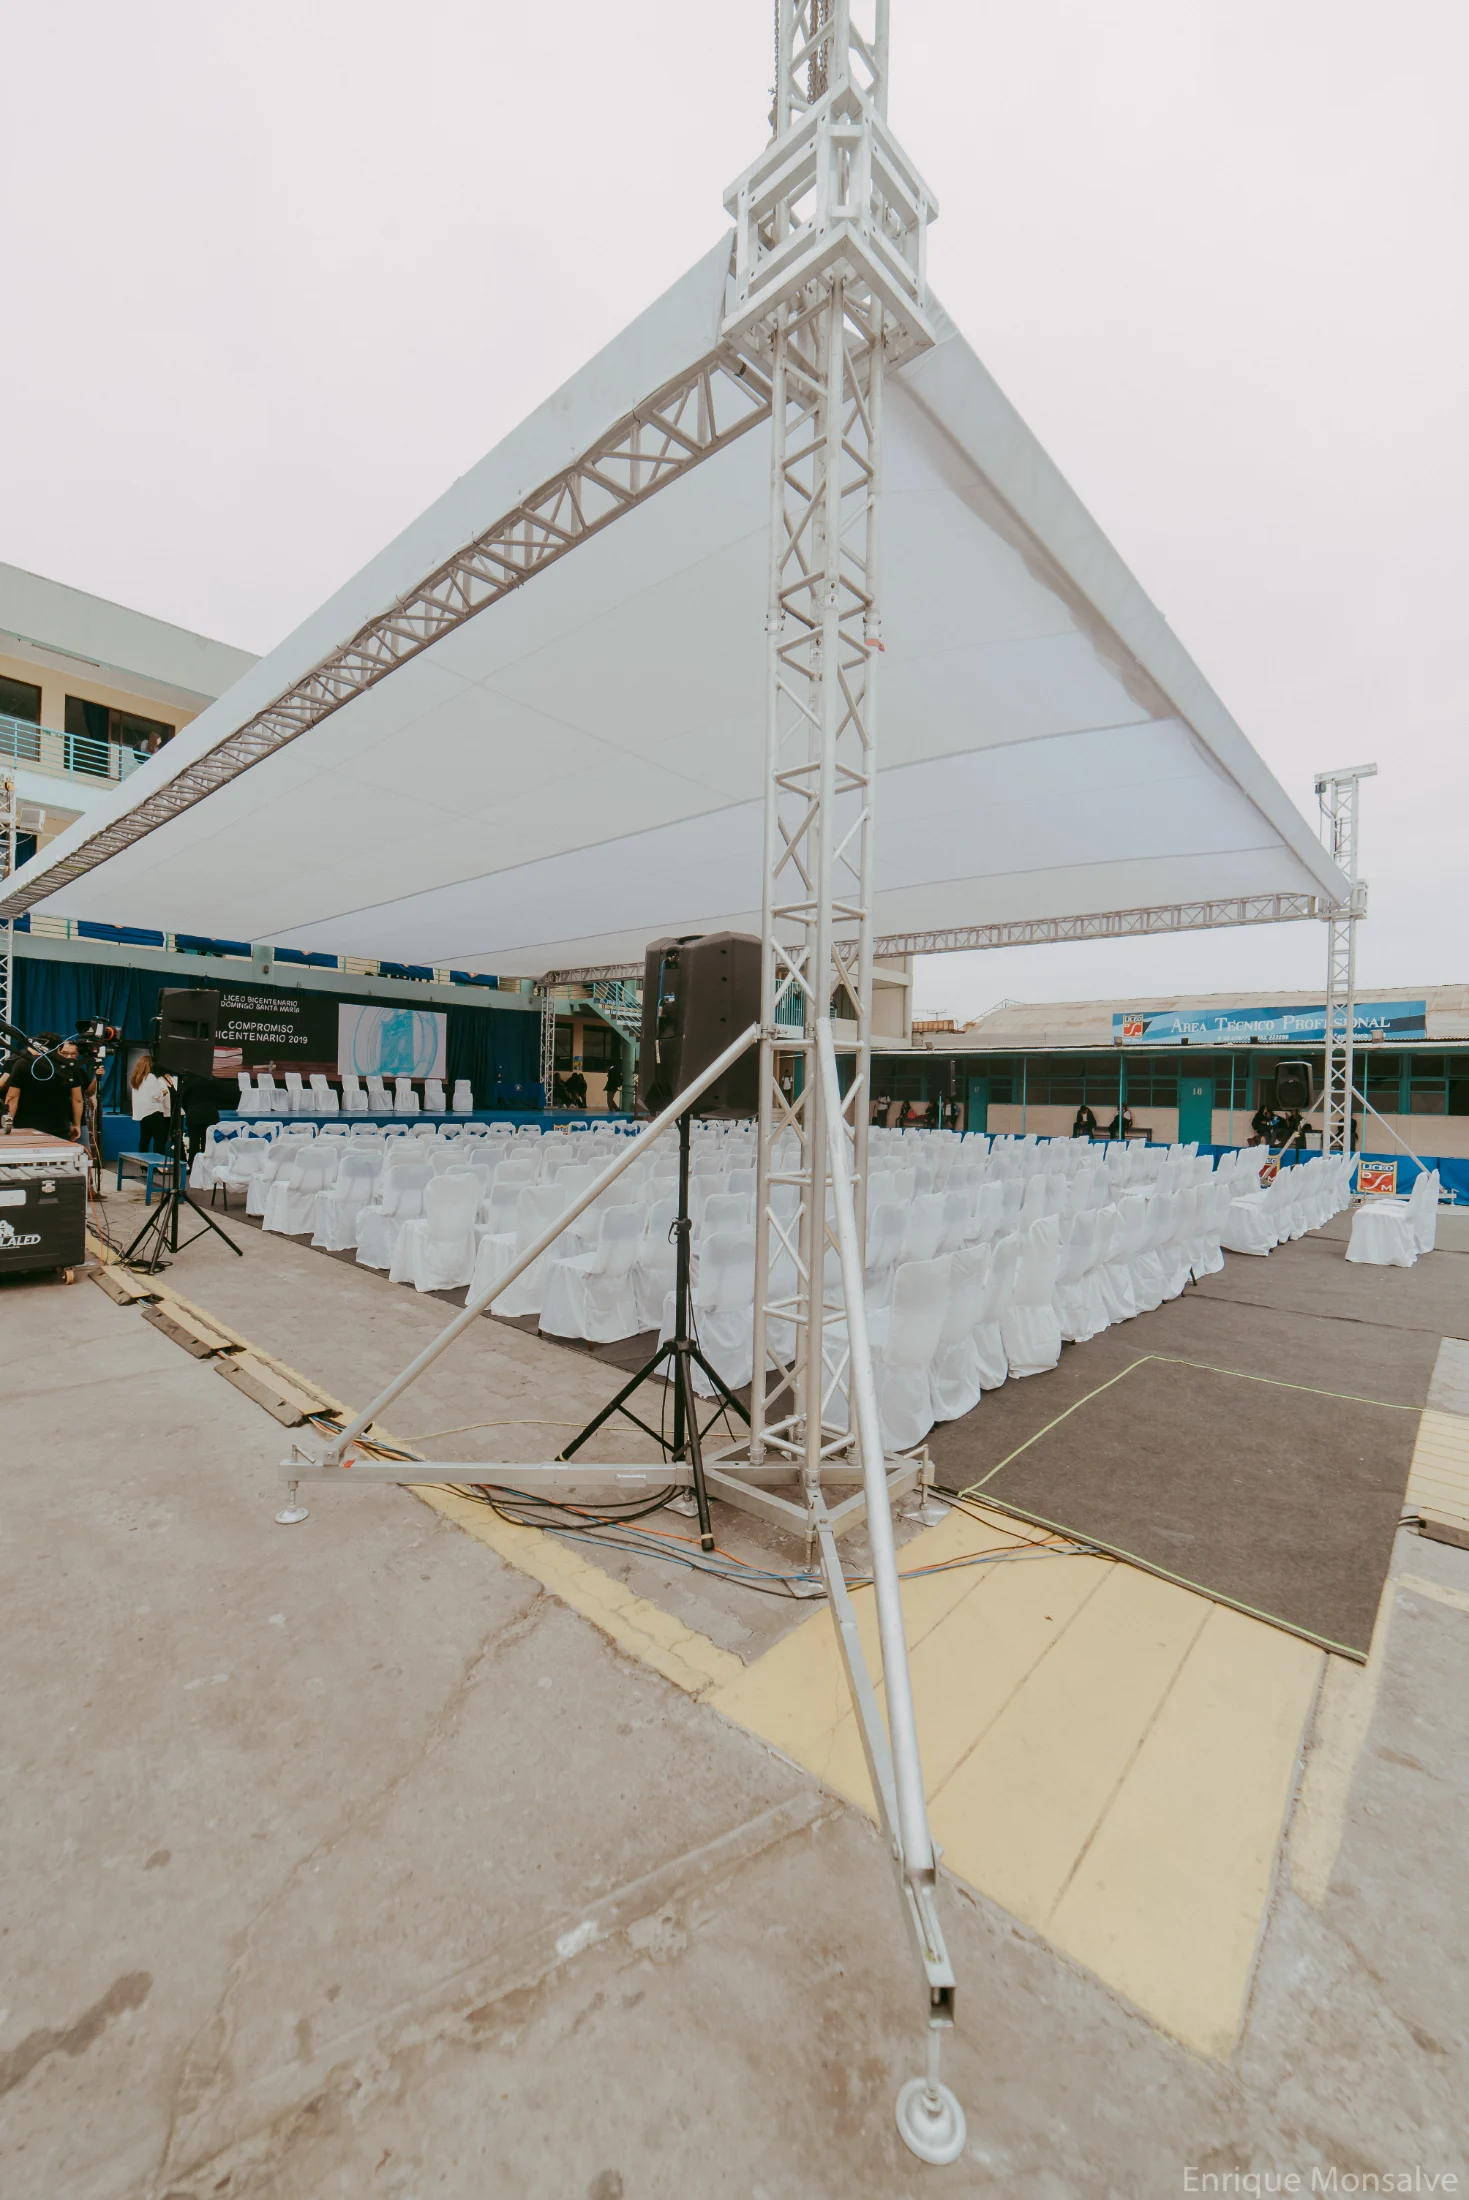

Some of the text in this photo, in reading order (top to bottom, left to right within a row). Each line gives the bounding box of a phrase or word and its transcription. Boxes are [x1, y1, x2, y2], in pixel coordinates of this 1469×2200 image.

[220, 1000, 255, 1010] DOMINGO
[255, 1004, 279, 1012] SANTA
[223, 994, 298, 1007] LICEO BICENTENARIO
[228, 1020, 294, 1034] COMPROMISO
[1282, 1015, 1391, 1030] PROFSIONAL
[288, 1035, 308, 1044] 2019
[1192, 1087, 1203, 1096] 18
[1362, 1163, 1394, 1171] LICEO
